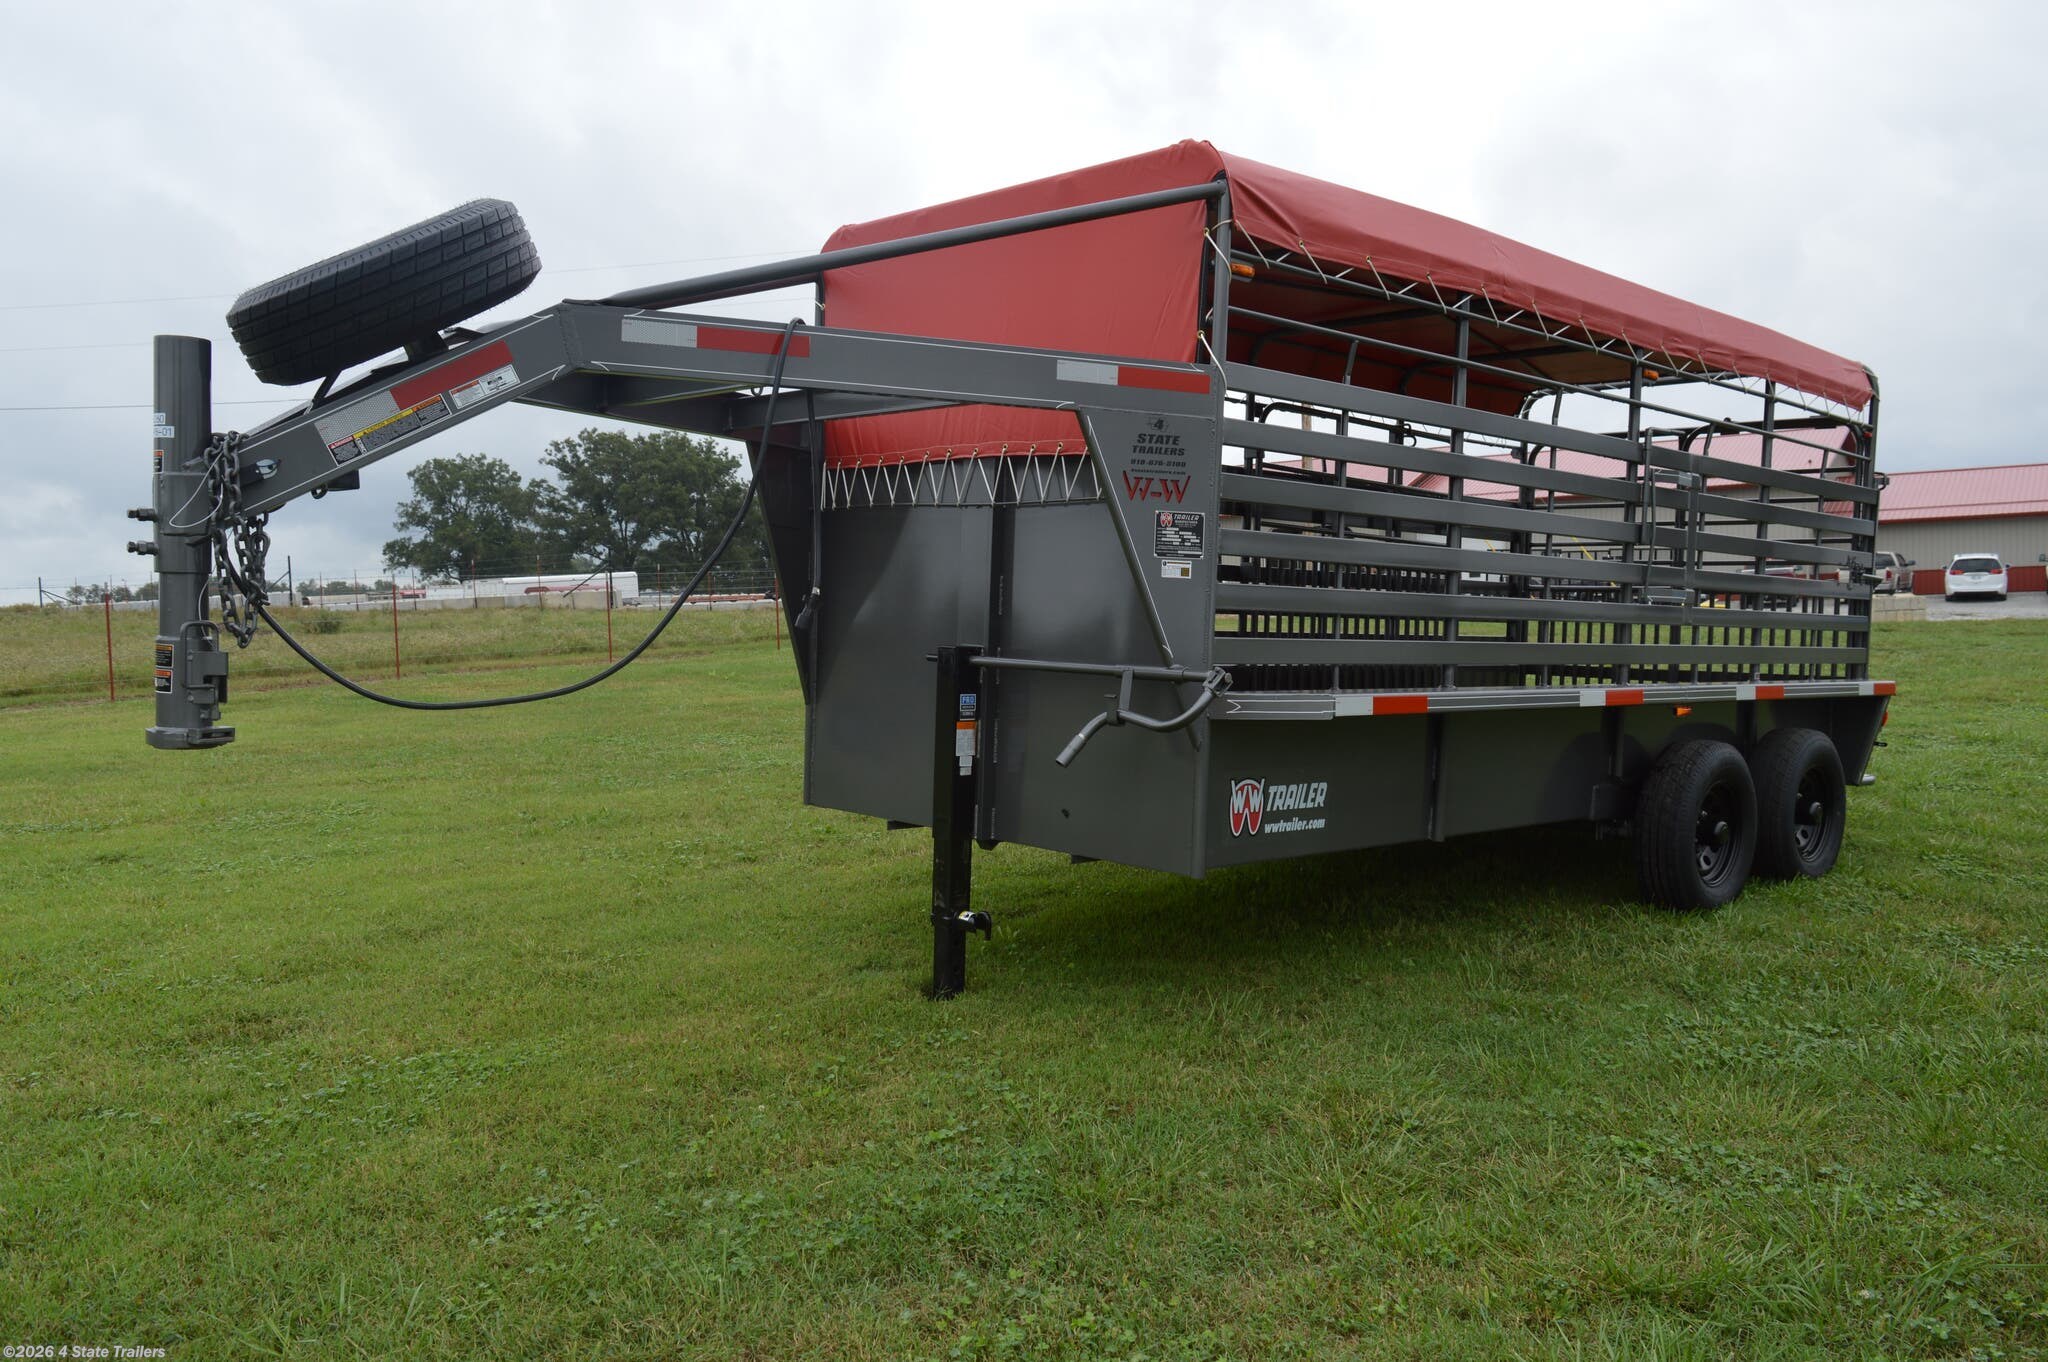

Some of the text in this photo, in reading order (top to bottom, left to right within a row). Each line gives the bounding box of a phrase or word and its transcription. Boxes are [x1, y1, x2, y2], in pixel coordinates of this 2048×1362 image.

[1151, 418, 1164, 430] 4
[1136, 433, 1181, 446] STATE
[1131, 445, 1185, 456] TRAILERS
[1122, 470, 1191, 504] W-W
[1266, 782, 1328, 812] TRAILER
[1264, 817, 1326, 834] wwtrailer.com
